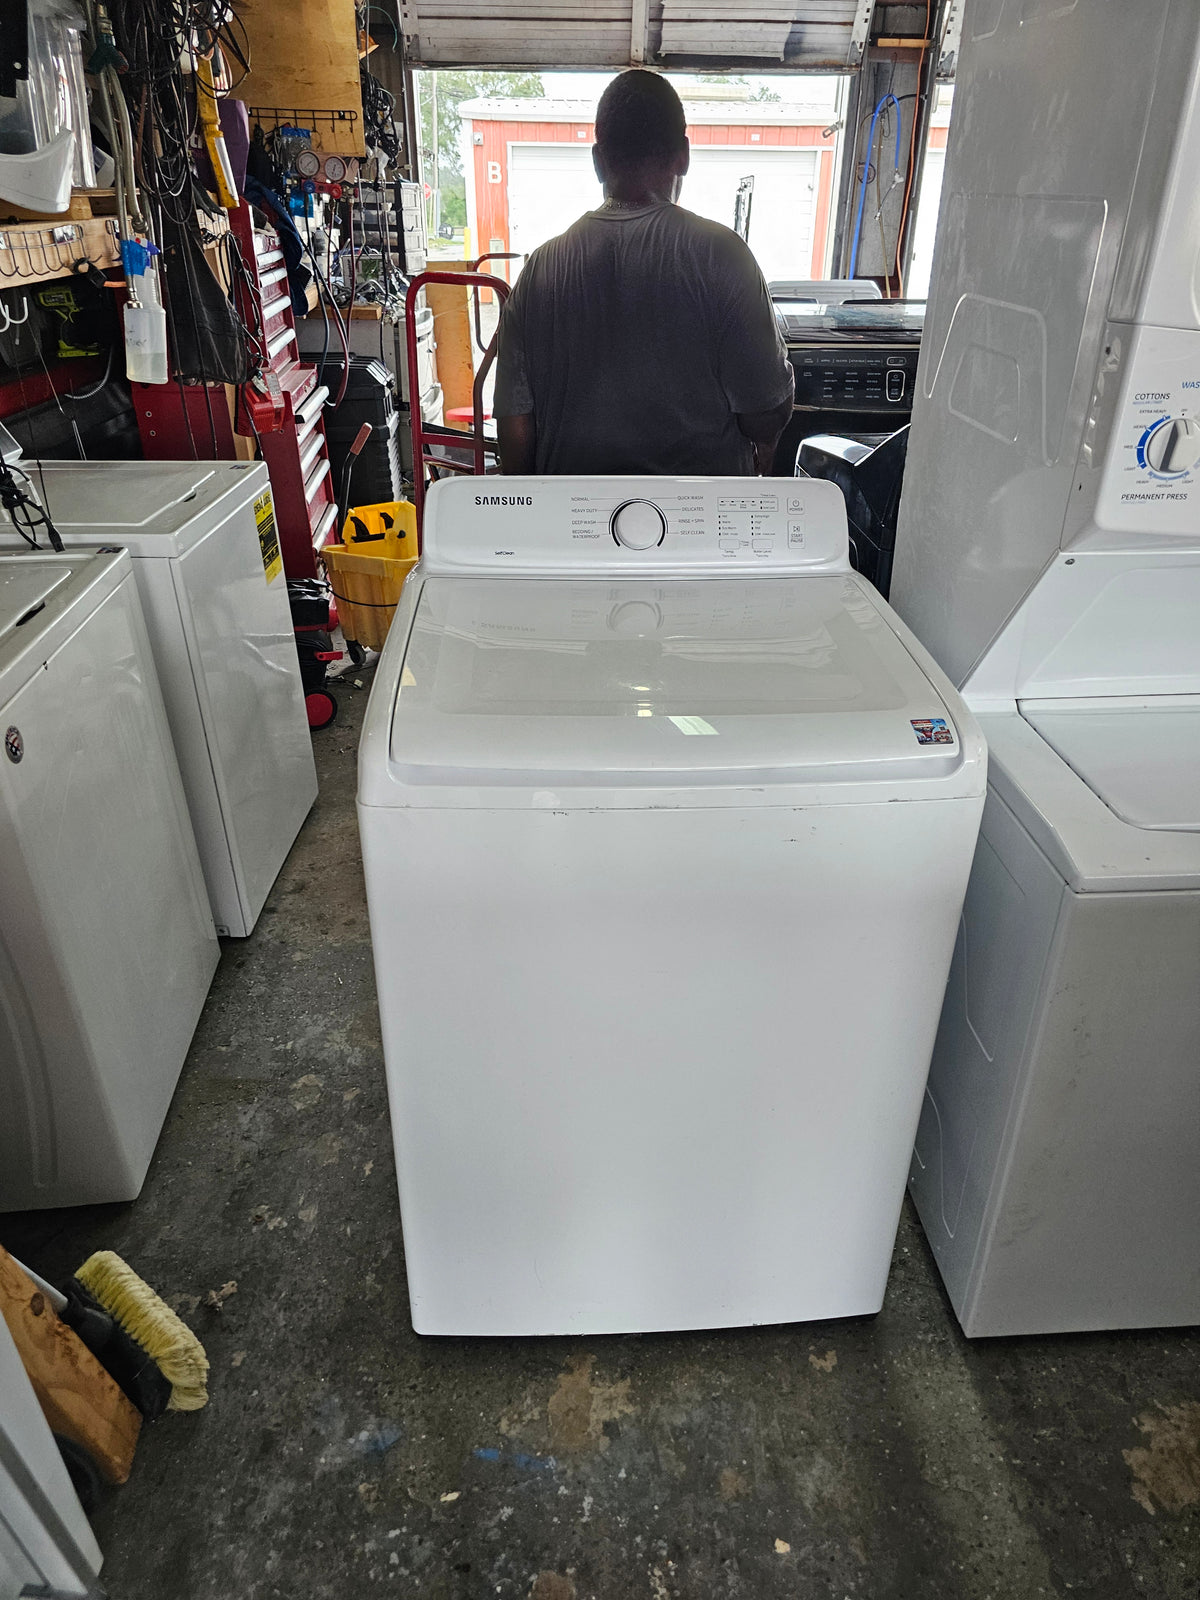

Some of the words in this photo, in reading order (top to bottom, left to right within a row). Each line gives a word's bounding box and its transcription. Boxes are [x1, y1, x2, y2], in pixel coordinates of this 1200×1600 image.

[487, 160, 503, 184] B
[1134, 393, 1170, 401] COTTONS
[475, 496, 533, 506] SAMSUNG
[1121, 493, 1165, 501] PERMANENT
[1166, 492, 1188, 500] PRESS
